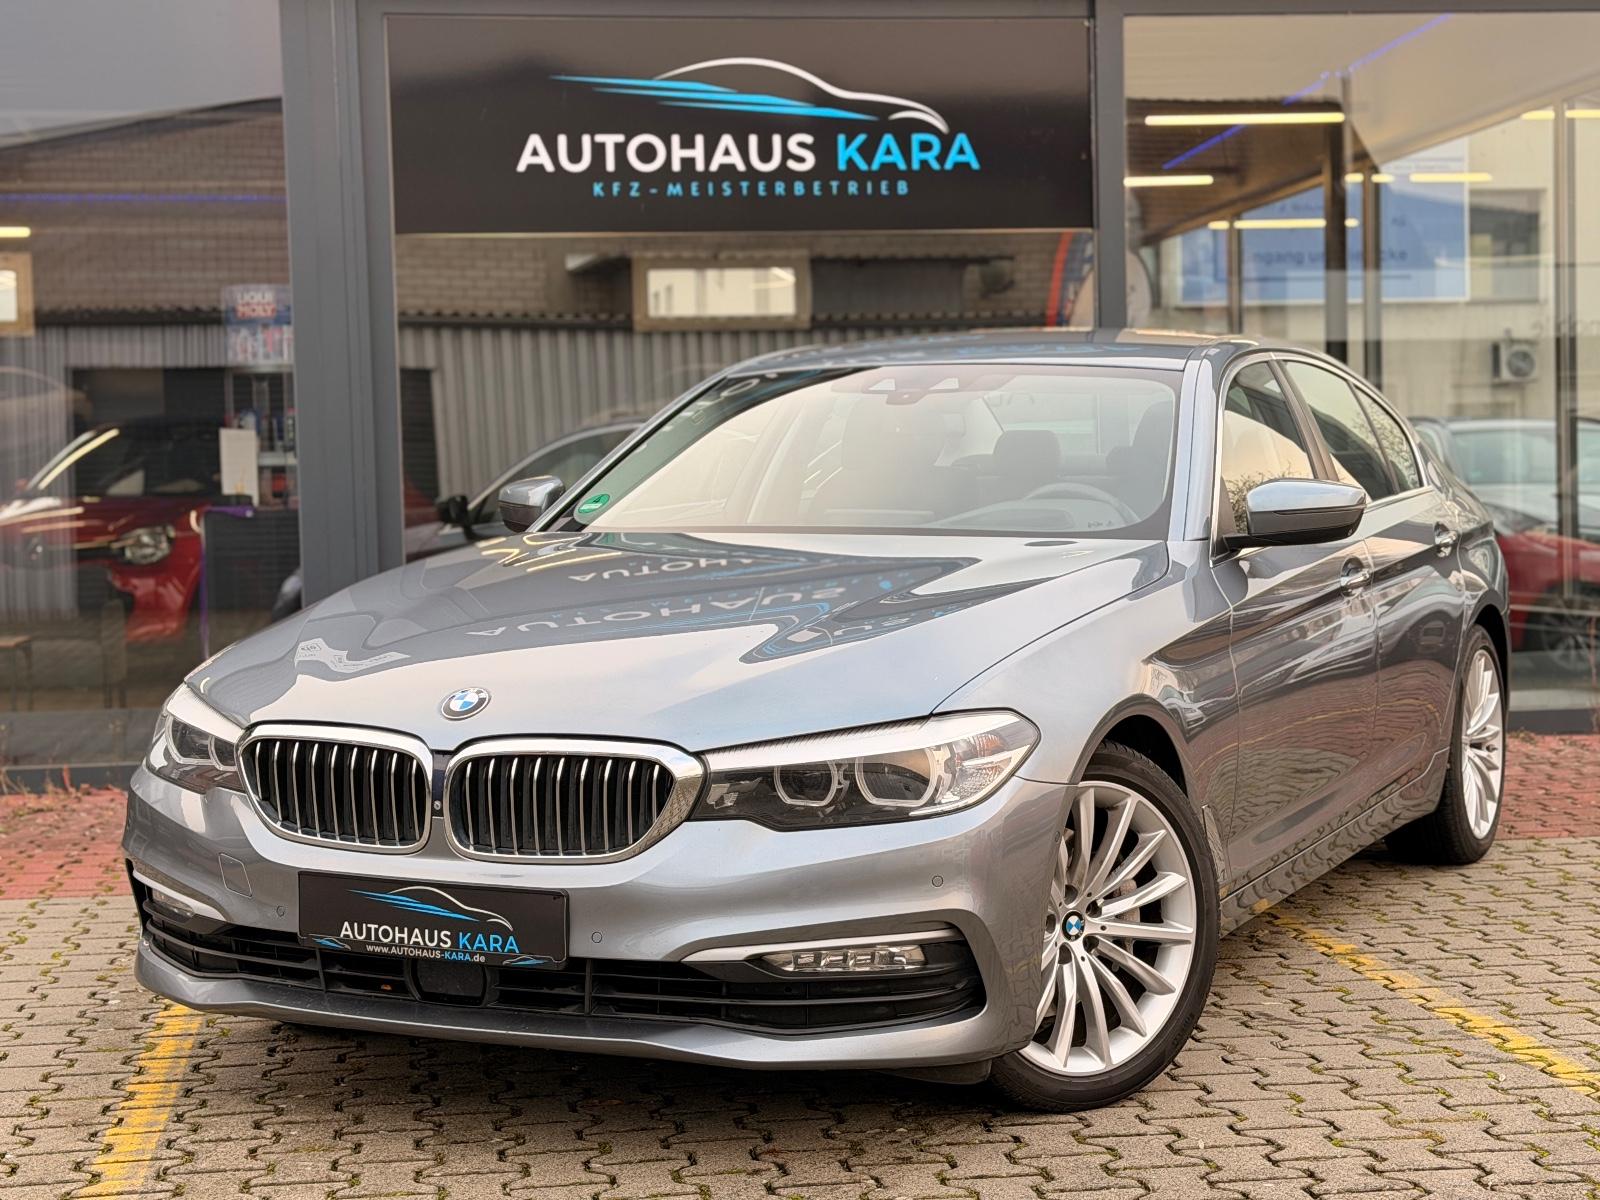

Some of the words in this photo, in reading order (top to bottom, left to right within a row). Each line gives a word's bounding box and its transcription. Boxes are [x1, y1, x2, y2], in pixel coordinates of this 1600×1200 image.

[515, 133, 817, 173] AUTOHAUS
[836, 132, 981, 171] KARA
[592, 180, 910, 197] KFZ-MEISTERBETRIEB
[340, 921, 452, 948] AUTOHAUS
[459, 931, 520, 954] KARA
[366, 944, 486, 963] www.AUTOHAUS-KARA.de
